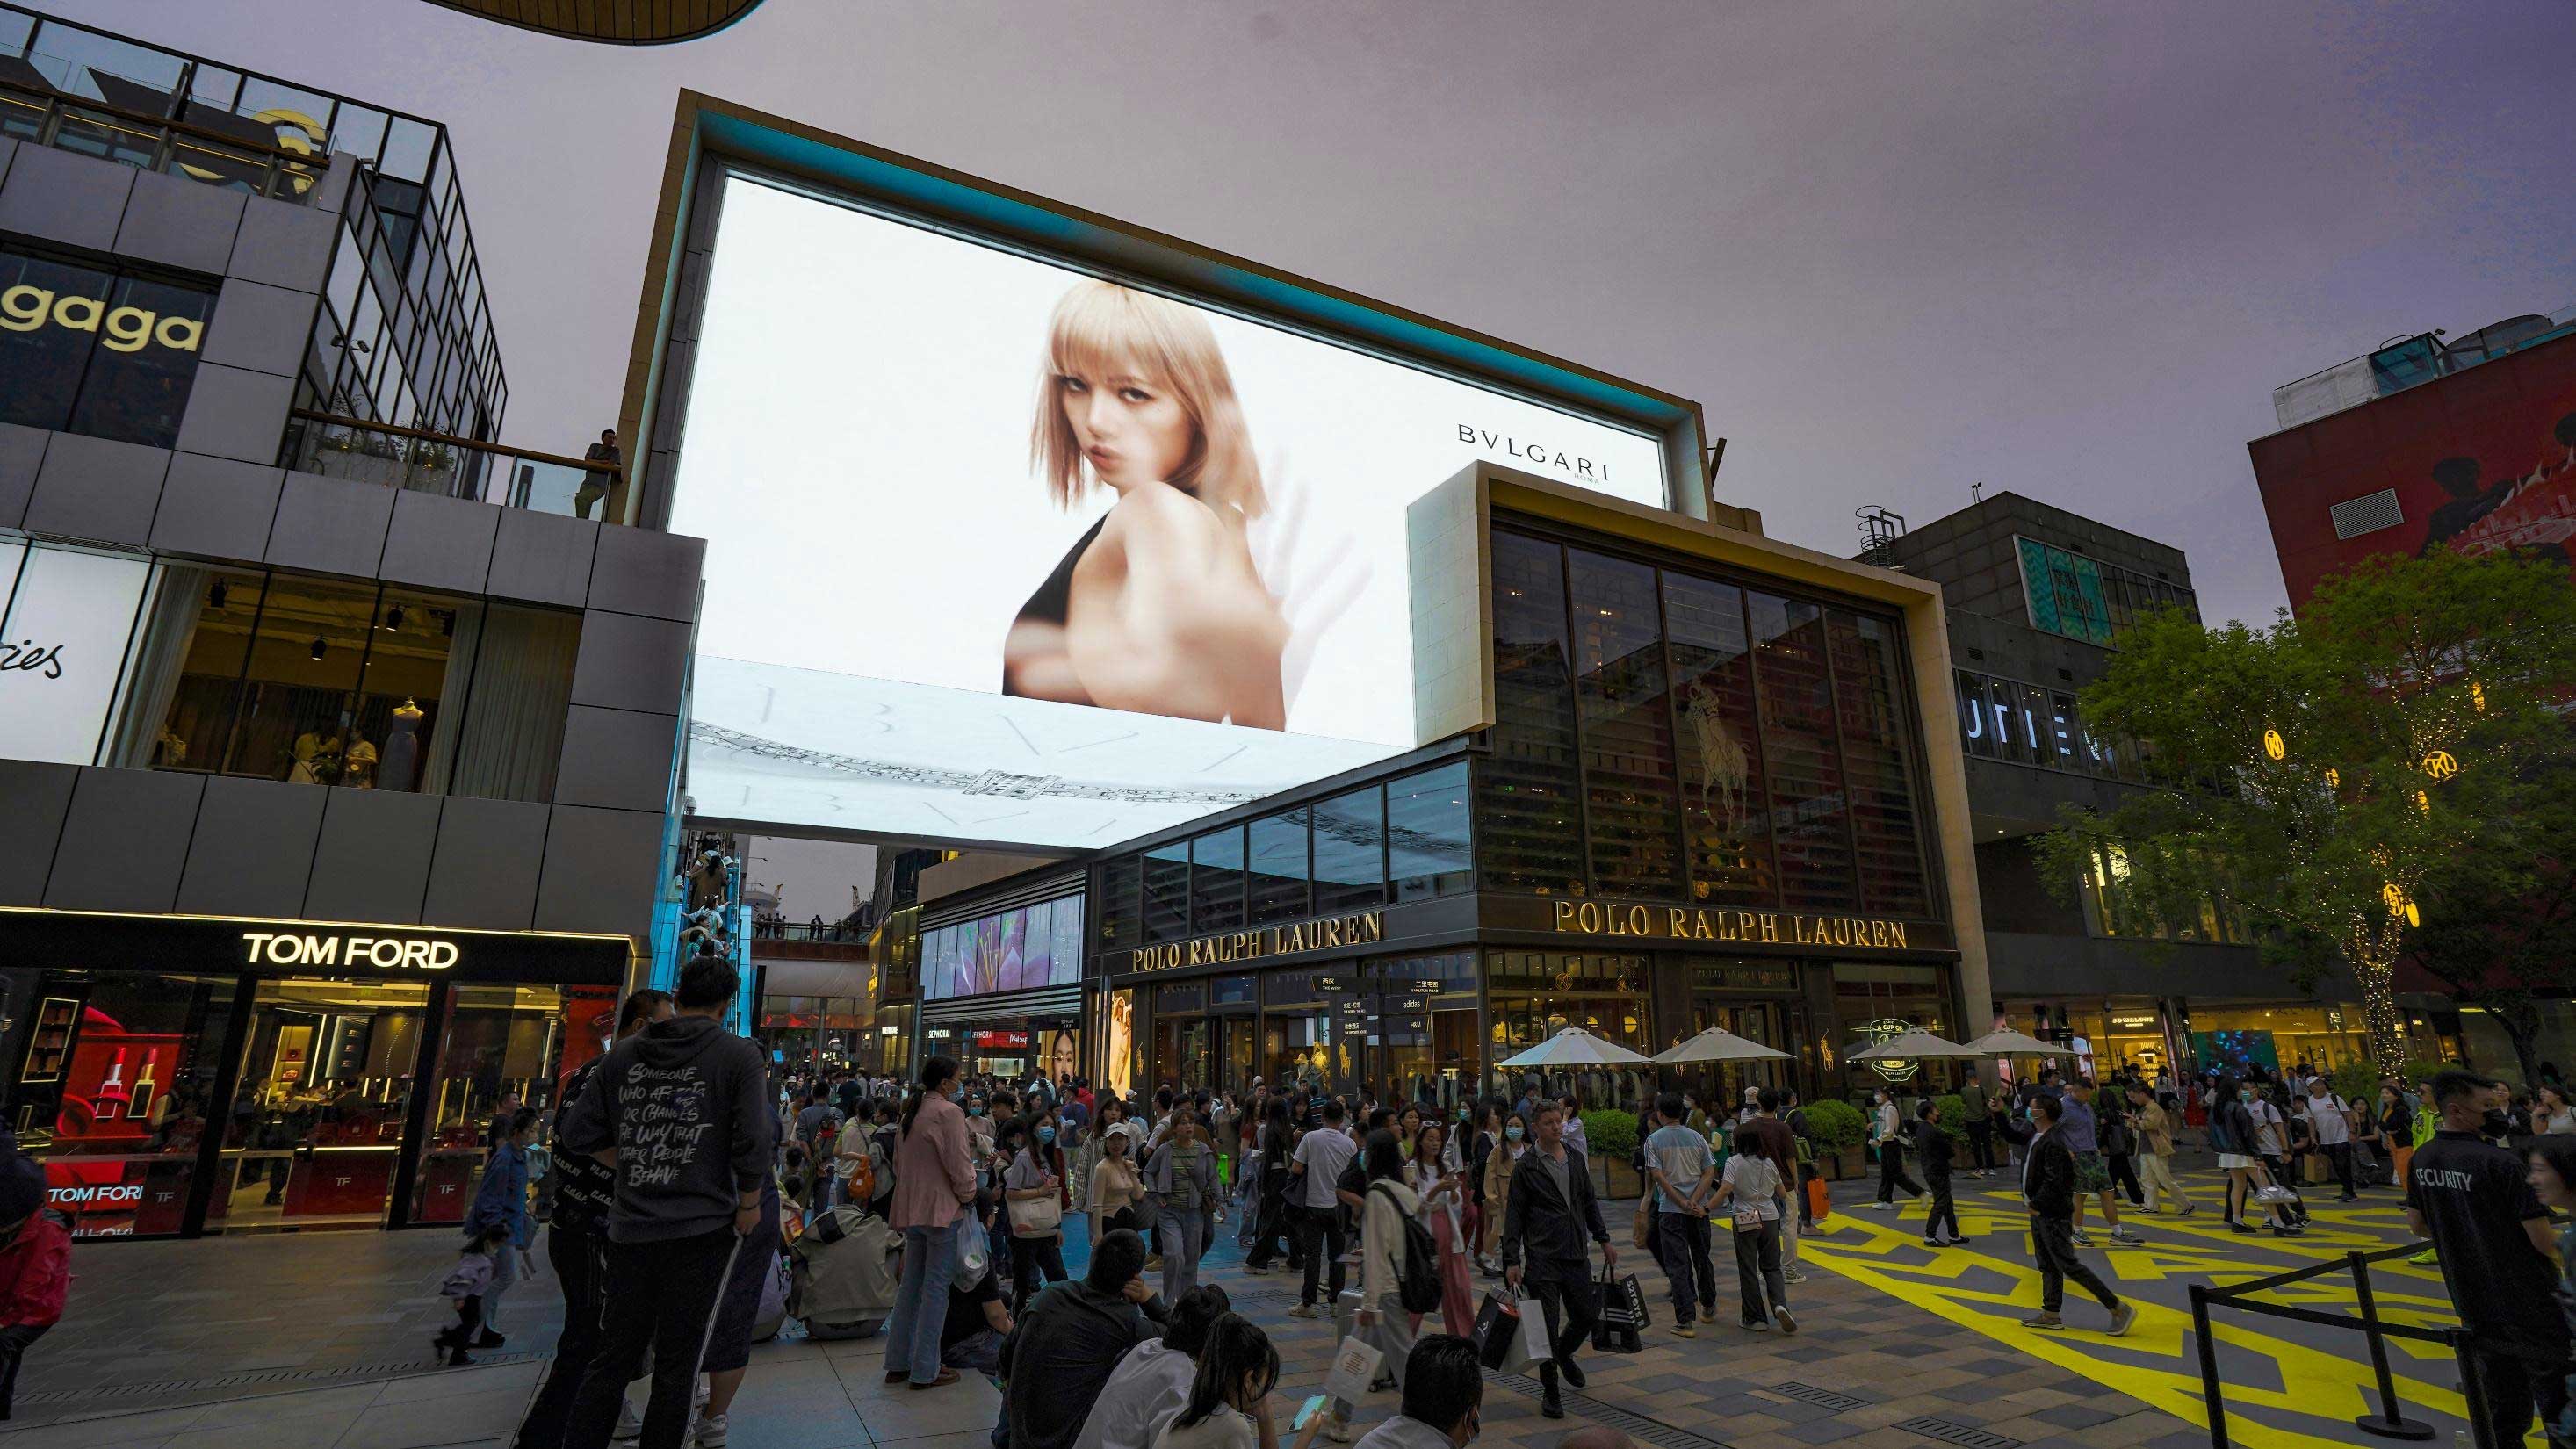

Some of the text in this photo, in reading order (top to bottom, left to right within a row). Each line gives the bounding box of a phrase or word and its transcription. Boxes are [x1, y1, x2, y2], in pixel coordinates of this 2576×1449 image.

[0, 285, 205, 352] gaga
[1457, 423, 1608, 481] BVLGARI
[1574, 472, 1600, 485] ROMA
[1555, 900, 1908, 948] POLO RALPH LAUREN
[242, 933, 458, 970] TOM FORD
[1131, 912, 1383, 973] POLO RALPH LAUREN
[1403, 1000, 1421, 1009] adidas
[928, 1029, 950, 1039] SEPHORA
[627, 1062, 698, 1084] SOMEONE
[618, 1085, 646, 1104] WHO
[624, 1107, 639, 1123] OR
[636, 1122, 674, 1145] WAY
[673, 1123, 714, 1144] THAT
[651, 1143, 697, 1165] PEOPLE
[336, 1177, 352, 1186] TF
[627, 1164, 682, 1187] BEHAVE
[48, 1186, 96, 1203] TOM
[155, 1192, 175, 1203] TF
[440, 1184, 456, 1194] TF
